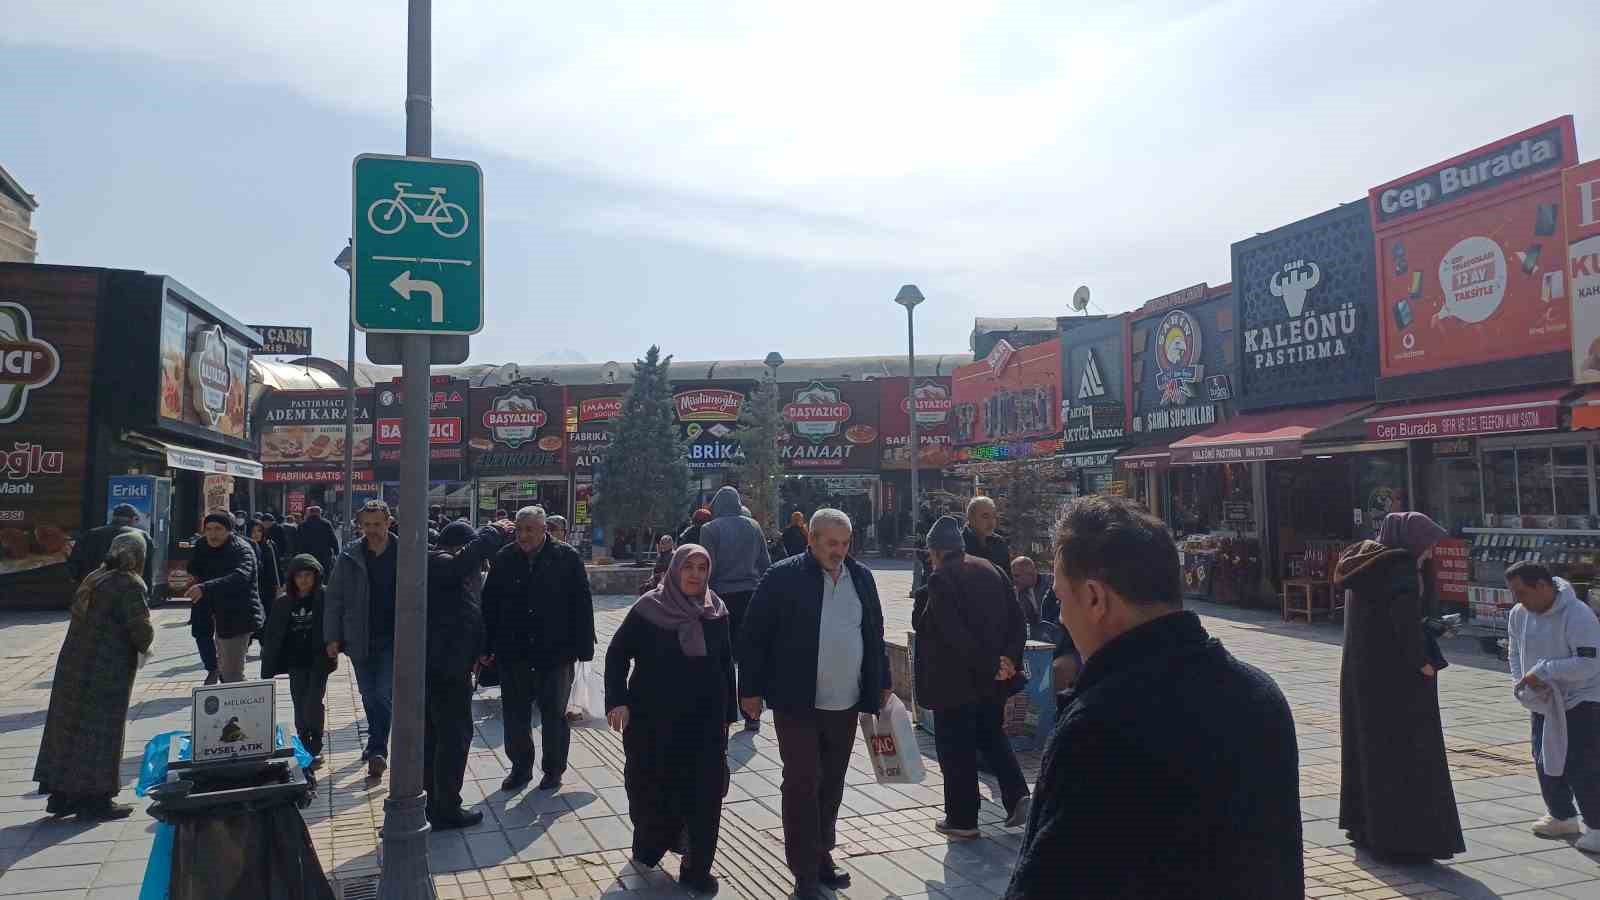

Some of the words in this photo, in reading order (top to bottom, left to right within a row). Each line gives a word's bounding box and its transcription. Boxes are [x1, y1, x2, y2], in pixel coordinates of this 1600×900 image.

[1380, 181, 1432, 213] Cep
[1439, 138, 1550, 194] Burada
[1455, 274, 1469, 286] 12
[1244, 302, 1357, 353] KALEÖNÜ
[1255, 339, 1346, 369] PASTIRMA
[265, 408, 307, 421] ADEM
[1170, 404, 1216, 428] SUCUKLARI
[381, 424, 454, 439] BAZICI
[1376, 424, 1396, 440] Cep
[1399, 421, 1438, 436] Burada
[781, 444, 855, 458] KANAAT
[112, 484, 147, 497] Erikli
[240, 743, 264, 752] ATIK
